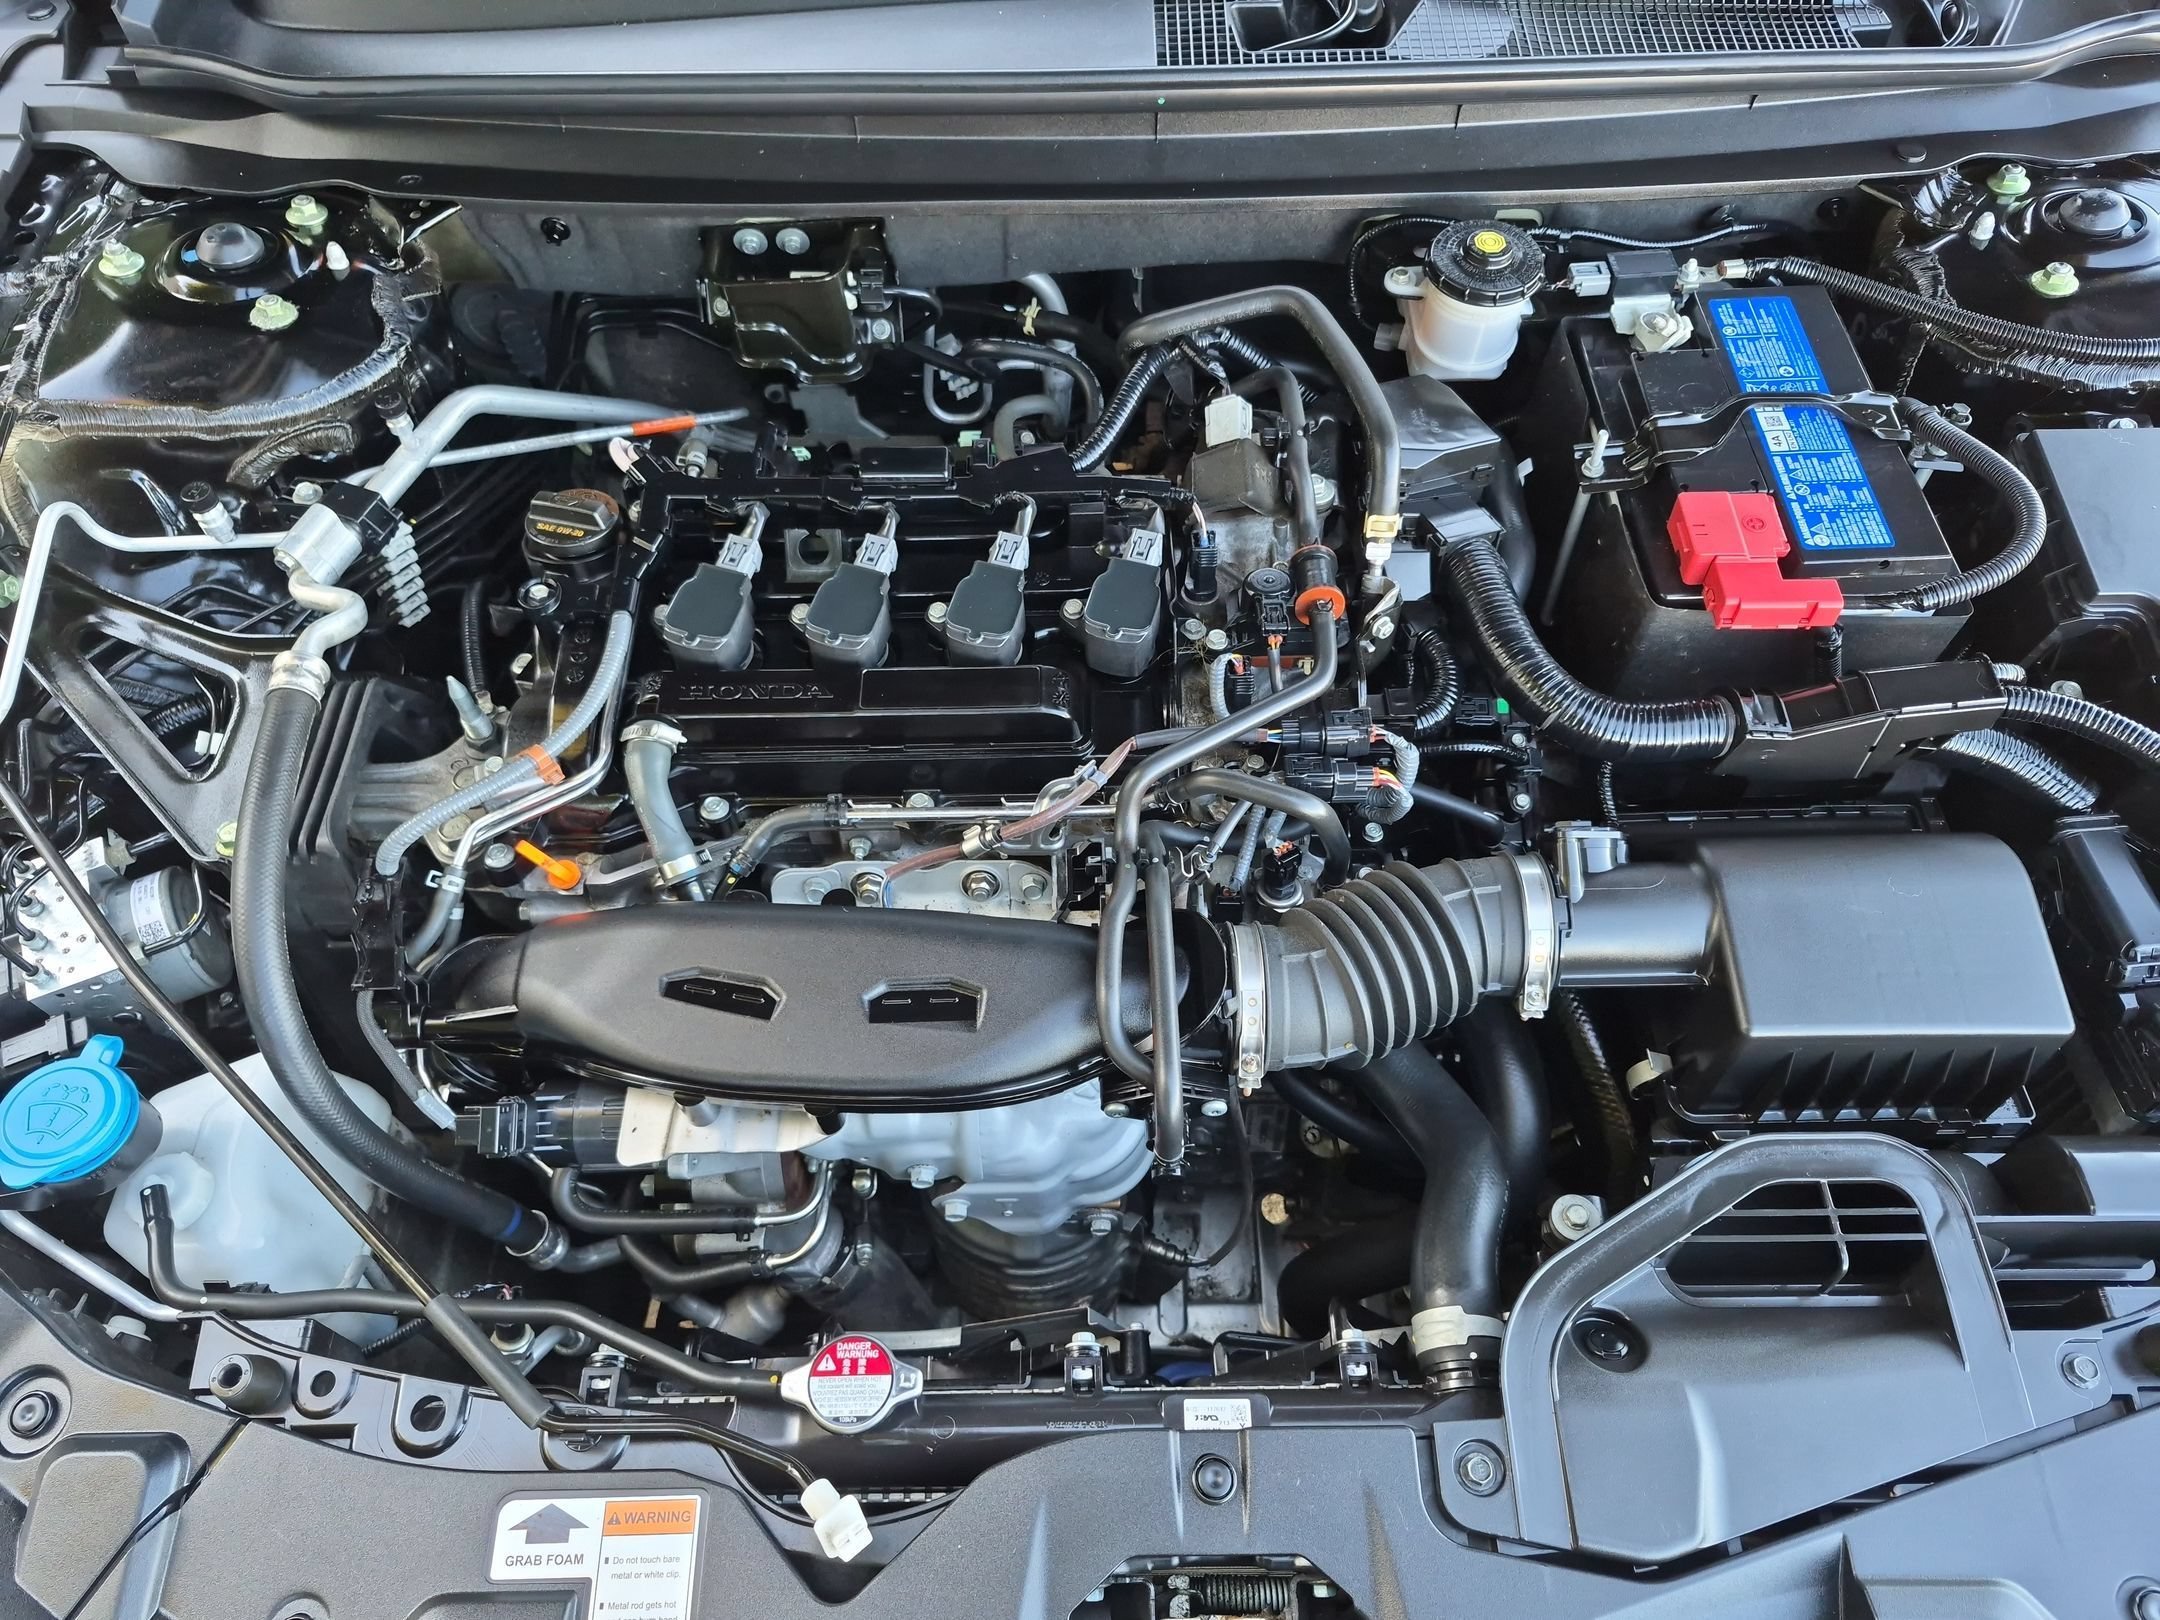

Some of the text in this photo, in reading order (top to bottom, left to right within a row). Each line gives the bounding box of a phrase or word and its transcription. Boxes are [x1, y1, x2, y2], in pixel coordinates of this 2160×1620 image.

[1771, 434, 1782, 448] 4A
[536, 522, 585, 538] SAE 0W-20
[678, 683, 834, 700] HONDA
[837, 1341, 872, 1350] DANGER
[837, 1350, 879, 1358] WARNUNG
[624, 1510, 691, 1524] WARNING
[505, 1553, 585, 1567] GRAB FOAM
[612, 1555, 681, 1565] Do not touch bare
[611, 1571, 633, 1580] metal
[644, 1570, 664, 1578] white
[666, 1570, 681, 1580] clip.
[607, 1600, 677, 1612] Metal rod gets hot
